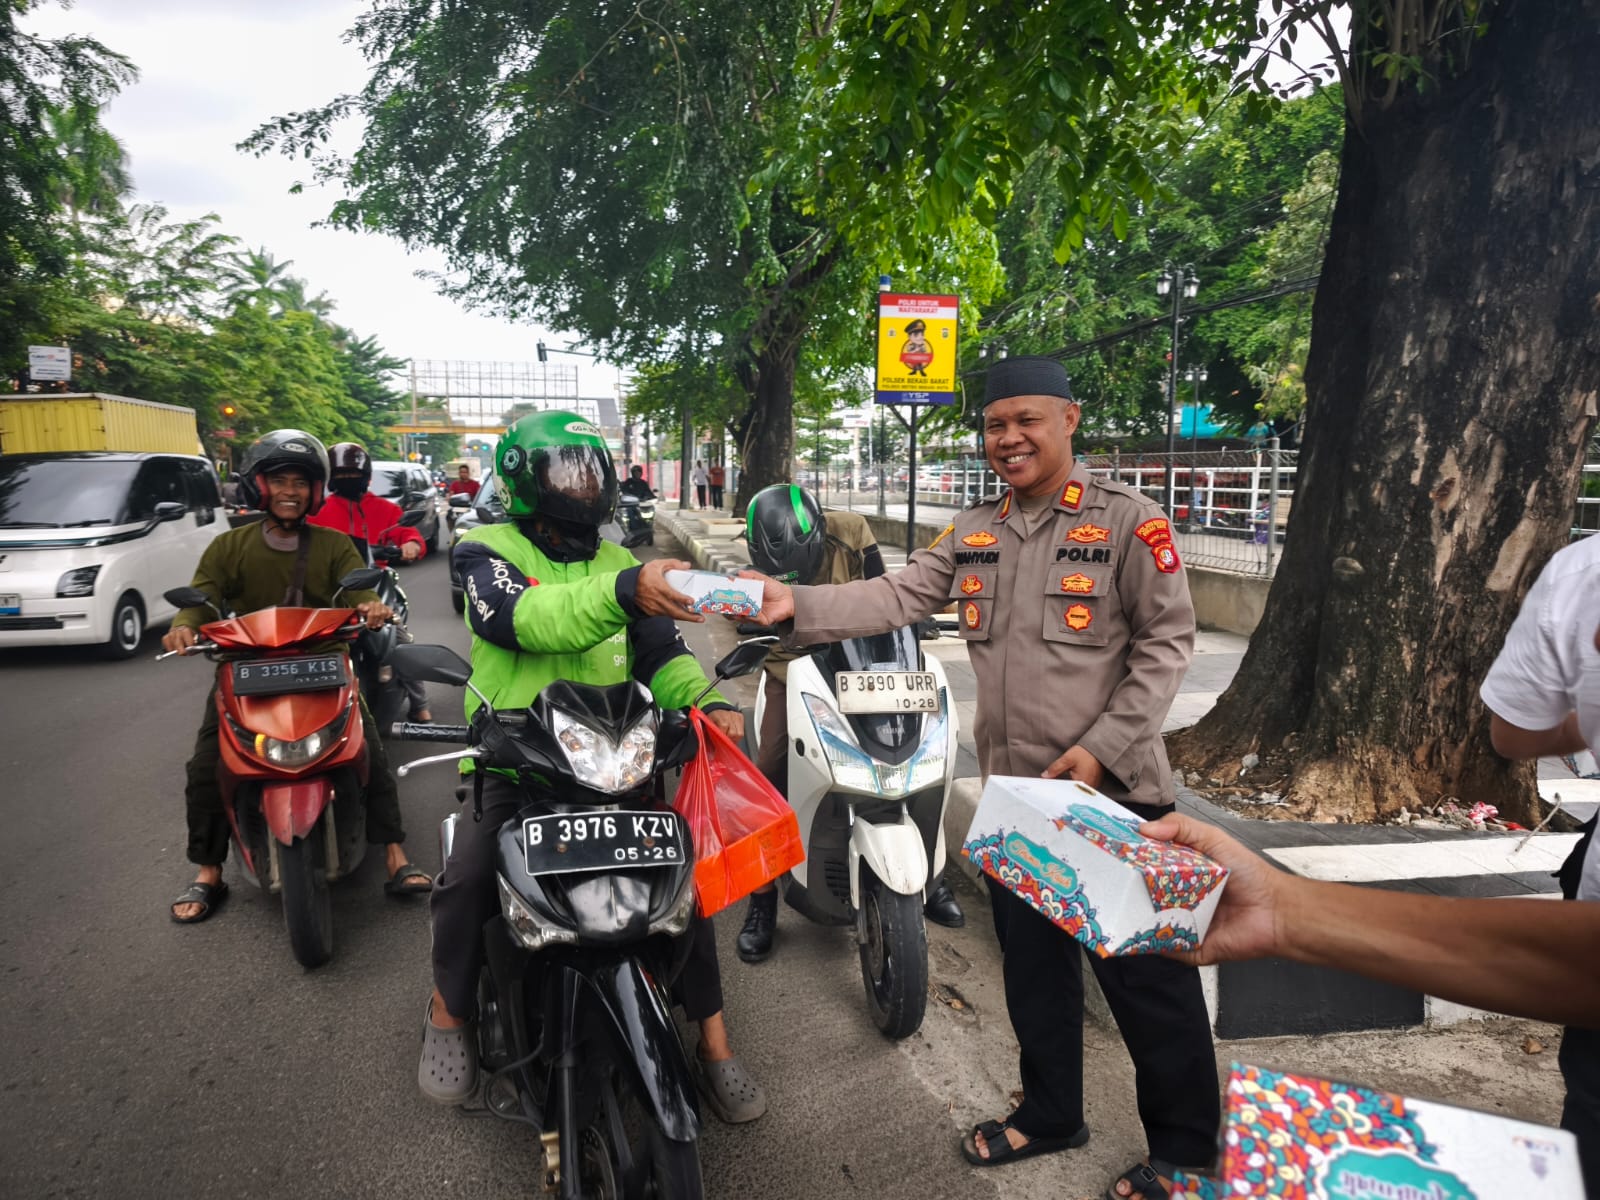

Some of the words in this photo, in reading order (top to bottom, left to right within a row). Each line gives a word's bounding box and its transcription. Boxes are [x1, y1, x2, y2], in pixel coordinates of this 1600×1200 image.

[1056, 548, 1110, 563] POLRI
[241, 667, 250, 679] B
[261, 664, 299, 677] 3356
[308, 660, 337, 673] KIS
[840, 675, 848, 691] B
[857, 675, 895, 691] 3890
[905, 675, 934, 691] URR
[529, 823, 543, 845] B
[558, 816, 617, 841] 3976
[632, 816, 674, 837] KZV
